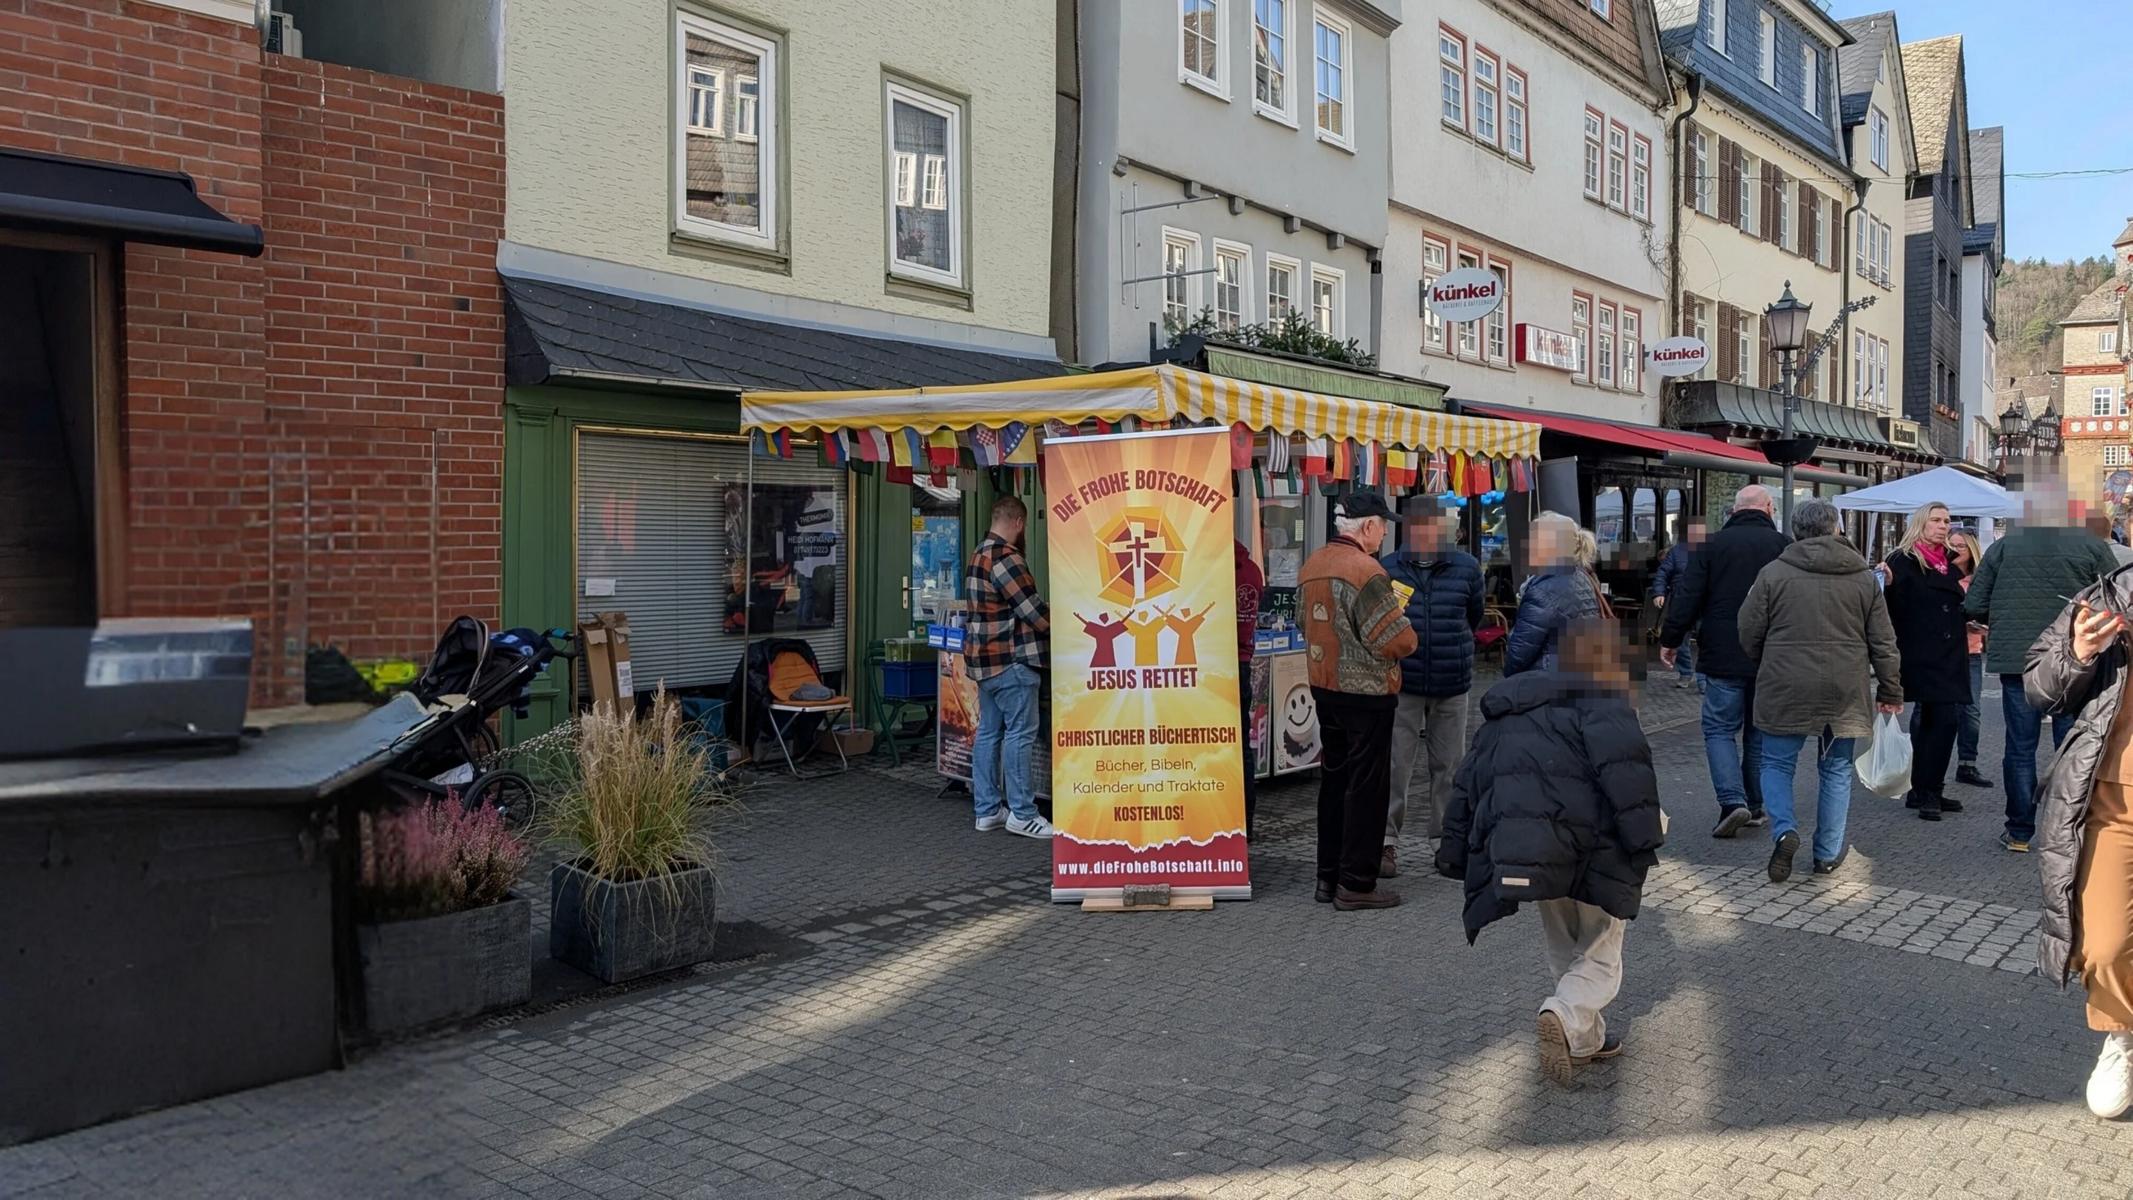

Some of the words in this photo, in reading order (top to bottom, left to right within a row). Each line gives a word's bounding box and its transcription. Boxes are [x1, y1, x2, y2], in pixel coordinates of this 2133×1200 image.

[1433, 280, 1496, 302] künkel
[1653, 346, 1705, 361] künkel
[1052, 493, 1082, 523] DIE
[1078, 471, 1131, 506] FROHE
[1135, 469, 1228, 514] BOTSCHAFT
[1087, 669, 1137, 690] JESUS
[1143, 667, 1198, 688] RETTET
[1057, 730, 1145, 747] CHRISTLICHER
[1149, 725, 1237, 745] BÜCHERTISCH
[1095, 758, 1148, 773] Bücher,
[1151, 758, 1197, 772] Bibeln,
[1073, 781, 1134, 794] Kalender
[1137, 781, 1164, 793] und
[1167, 780, 1225, 792] Traktate
[1114, 805, 1184, 822] KOSTENLOS!
[1058, 858, 1244, 875] www.dieFroheBotschaft.info
